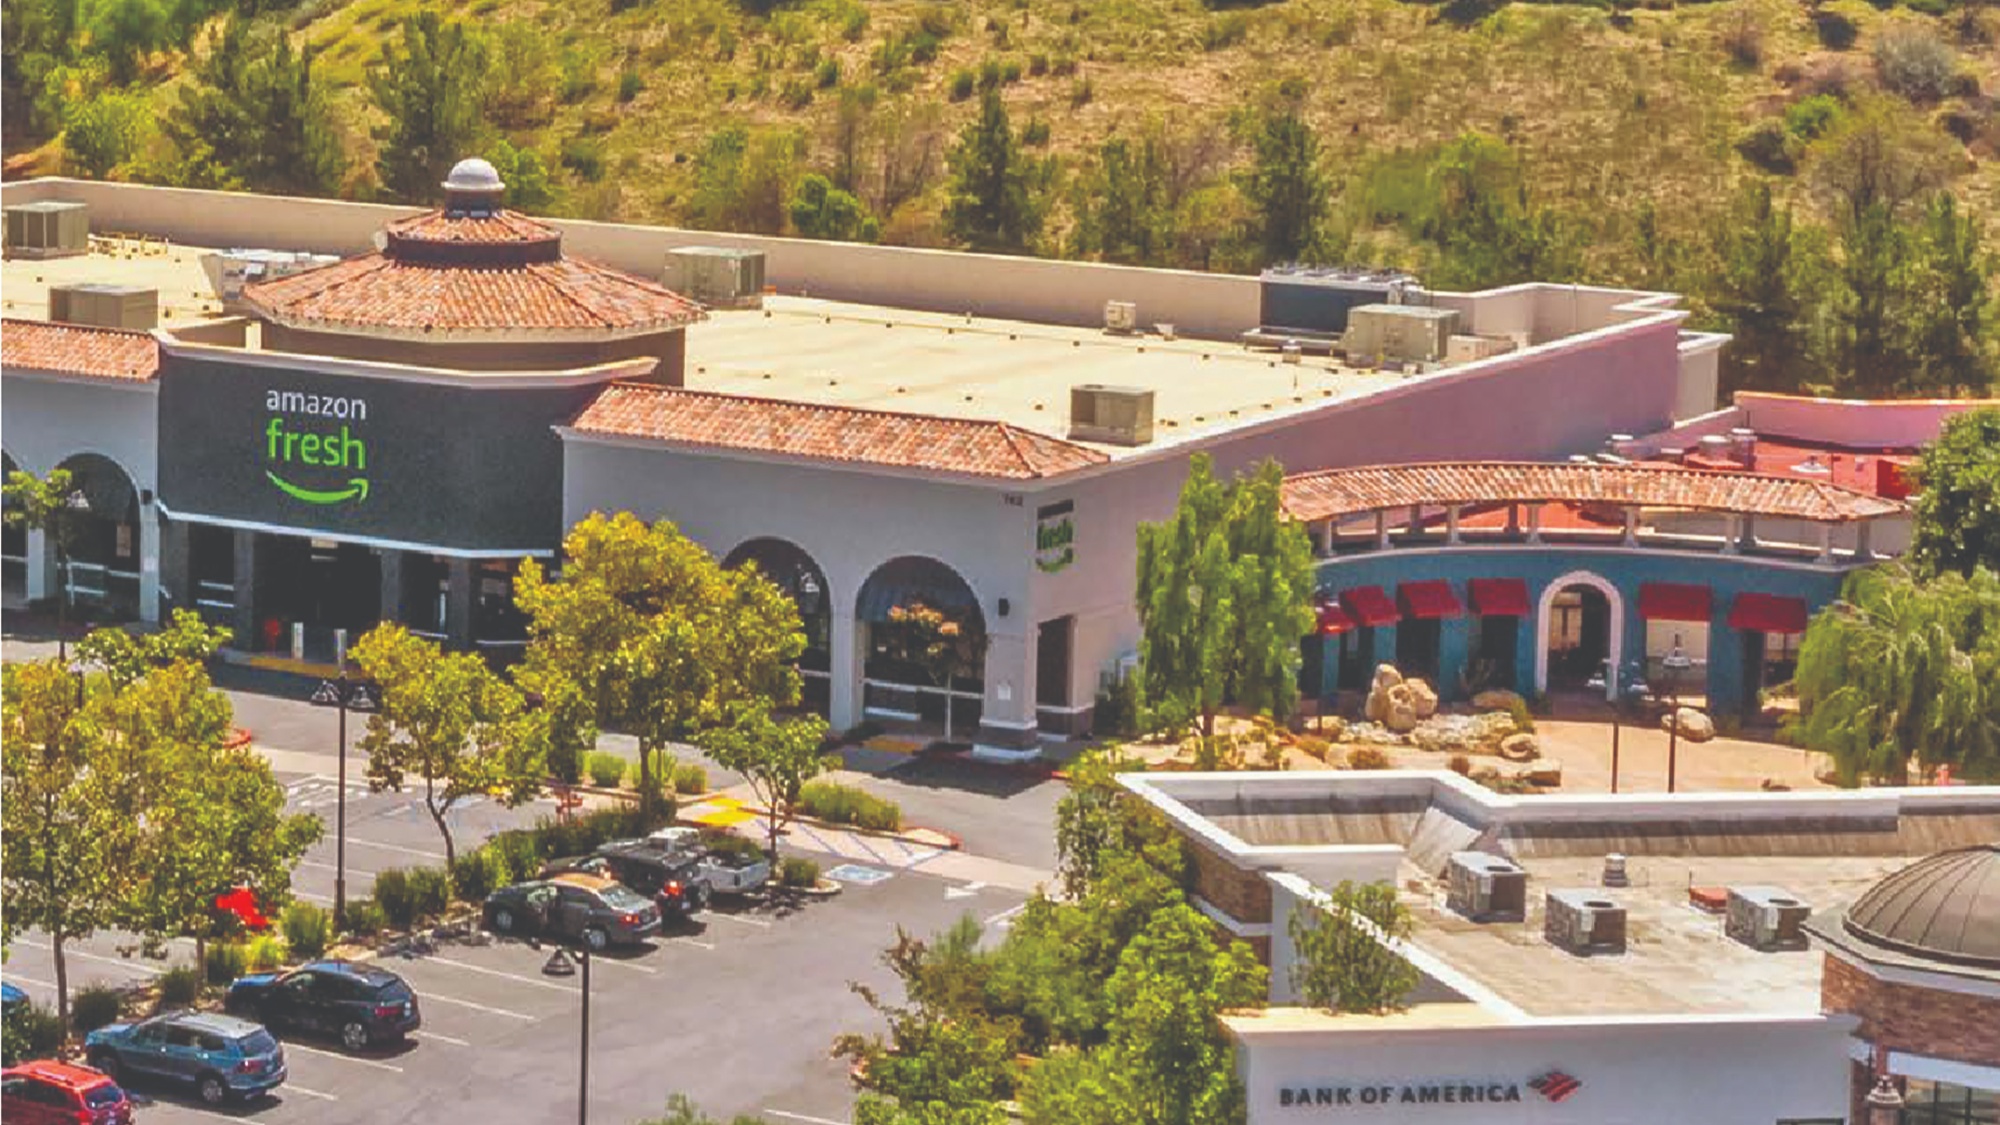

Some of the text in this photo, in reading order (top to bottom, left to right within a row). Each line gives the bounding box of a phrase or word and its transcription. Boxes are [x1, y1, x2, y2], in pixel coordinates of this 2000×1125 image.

[266, 389, 367, 420] amazon
[265, 418, 366, 470] fresh
[1280, 1084, 1521, 1107] BANK OF AMERICA
